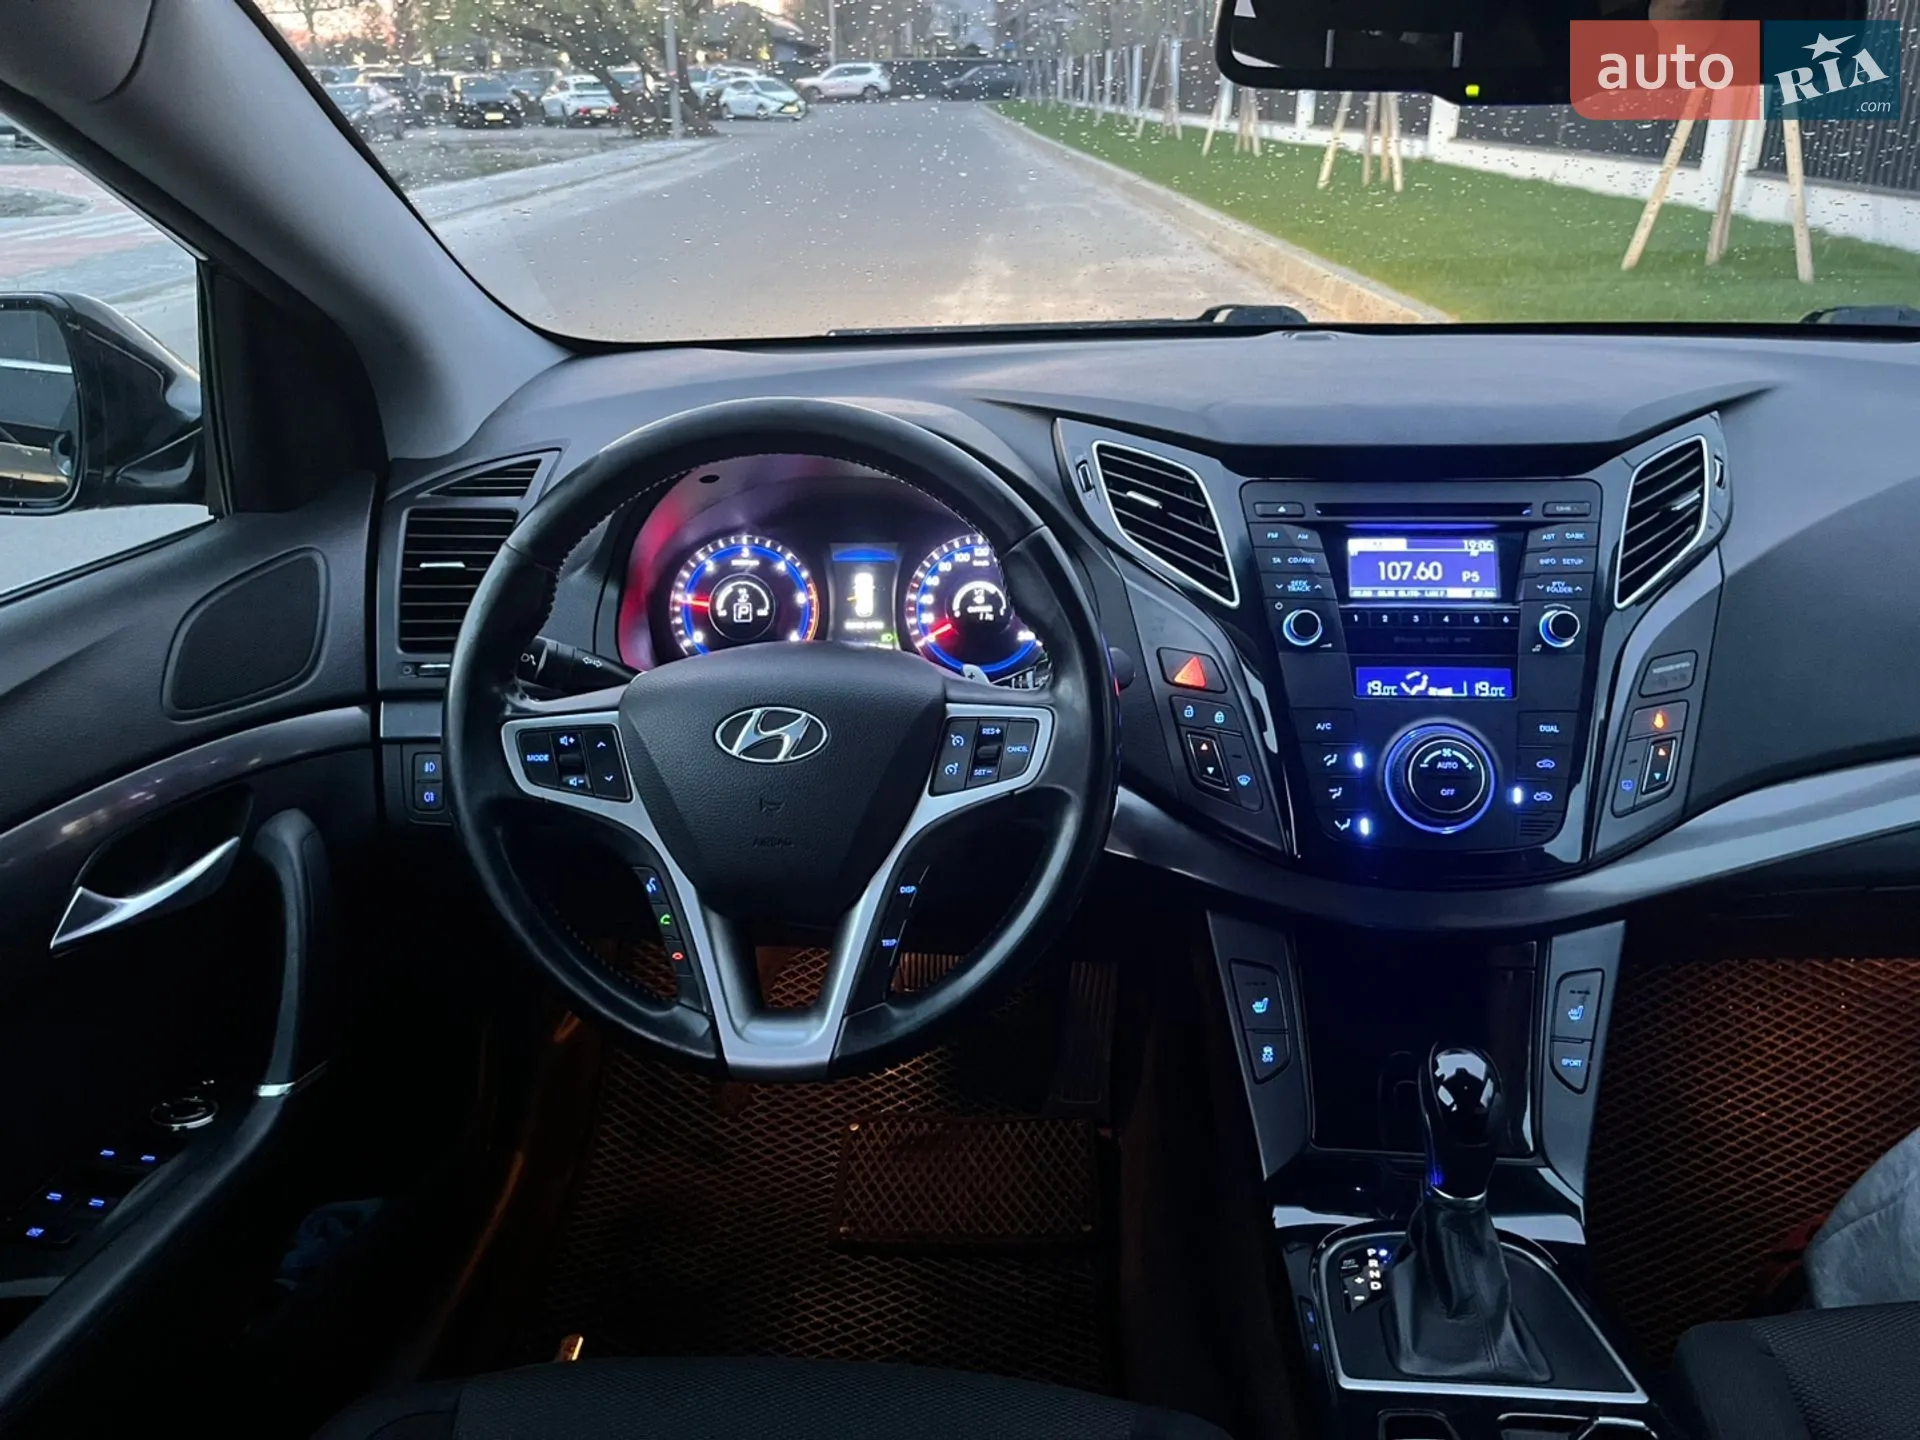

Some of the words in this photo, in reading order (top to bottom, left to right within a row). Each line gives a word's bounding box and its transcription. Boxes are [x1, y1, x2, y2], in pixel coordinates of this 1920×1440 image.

[1565, 532, 1585, 540] DARK
[1378, 561, 1443, 581] 107.60
[738, 606, 749, 619] P
[1354, 614, 1358, 622] 1
[1382, 614, 1388, 623] 2
[1413, 615, 1419, 623] 3
[1443, 615, 1450, 623] 4
[1316, 722, 1332, 730] A/C
[1539, 724, 1560, 733] DUAL
[900, 886, 916, 894] DISP
[882, 939, 897, 947] TRIP
[1562, 1058, 1582, 1067] SPORT
[1367, 1248, 1376, 1257] P
[1368, 1259, 1379, 1268] R
[1369, 1270, 1381, 1279] N
[1370, 1281, 1382, 1290] D
